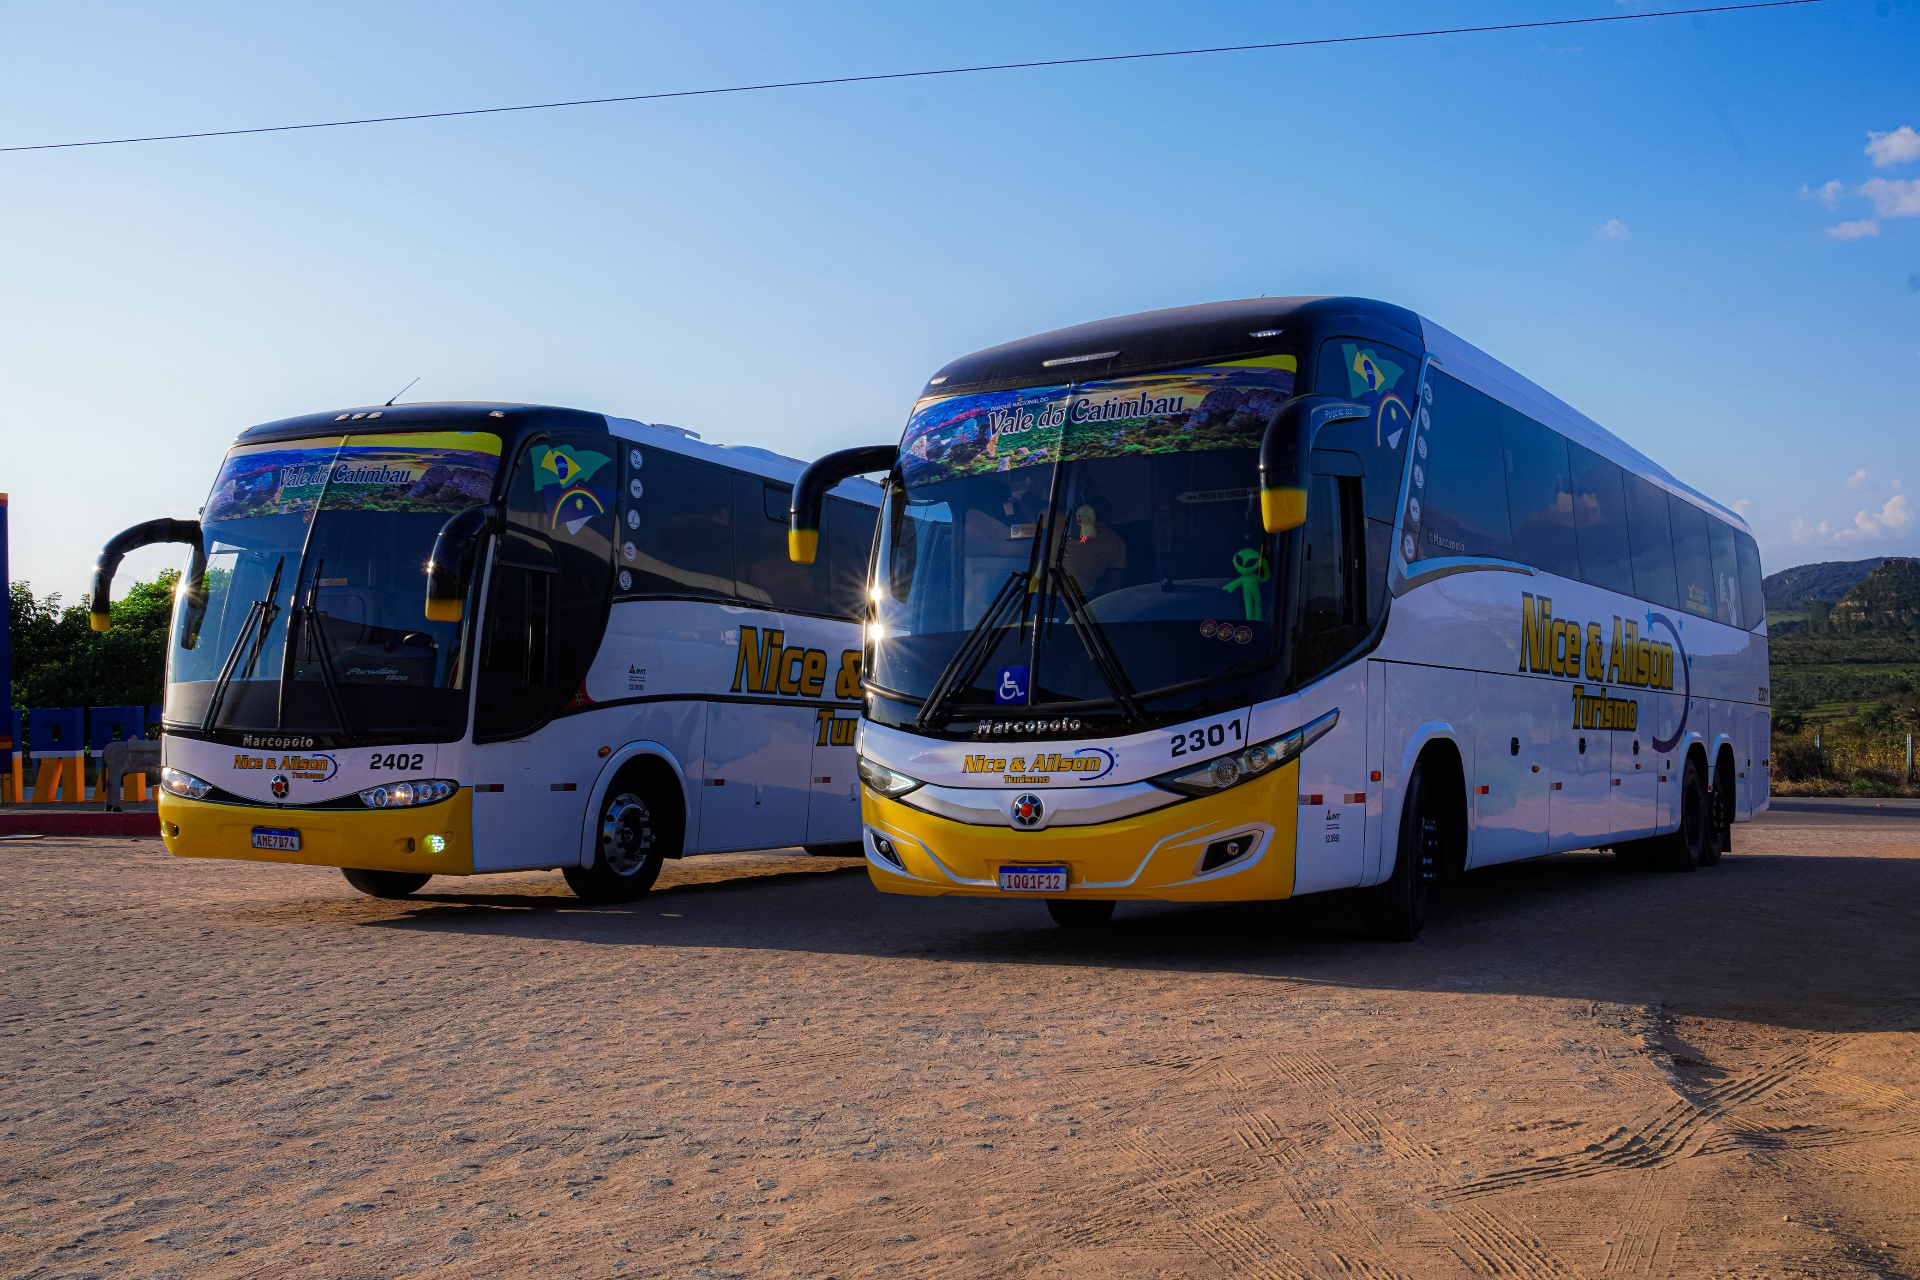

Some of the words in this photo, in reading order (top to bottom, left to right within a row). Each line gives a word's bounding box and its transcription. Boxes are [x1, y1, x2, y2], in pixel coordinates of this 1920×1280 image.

[1012, 399, 1040, 408] NACIONAL
[988, 407, 1033, 439] Vale
[1038, 402, 1066, 429] do
[1070, 391, 1185, 424] Catimbau
[280, 467, 310, 488] Vale
[310, 464, 330, 485] do
[332, 464, 411, 485] Catimbau
[1433, 533, 1466, 553] Marcopolo
[1518, 590, 1581, 678] Nice
[1585, 621, 1605, 682] &
[1607, 614, 1674, 691] Ailson
[729, 625, 827, 698] Nice
[835, 649, 862, 699] &
[346, 668, 398, 676] Paradiso
[1572, 684, 1638, 732] Turismo
[816, 709, 859, 746] Tur
[977, 717, 1081, 735] Marcopolo
[242, 734, 314, 748] Marcopolo
[1171, 719, 1242, 758] 2301
[233, 754, 264, 770] Nice
[265, 757, 277, 769] &
[278, 755, 328, 771] Ailson
[369, 753, 424, 770] 2402
[962, 754, 1006, 773] Nice
[1009, 756, 1027, 773] &
[1029, 753, 1102, 773] Ailson
[291, 771, 325, 780] Turismo
[1003, 774, 1050, 784] Turismo
[256, 834, 295, 849] AME7D74
[1006, 874, 1060, 890] IQQ1F12
